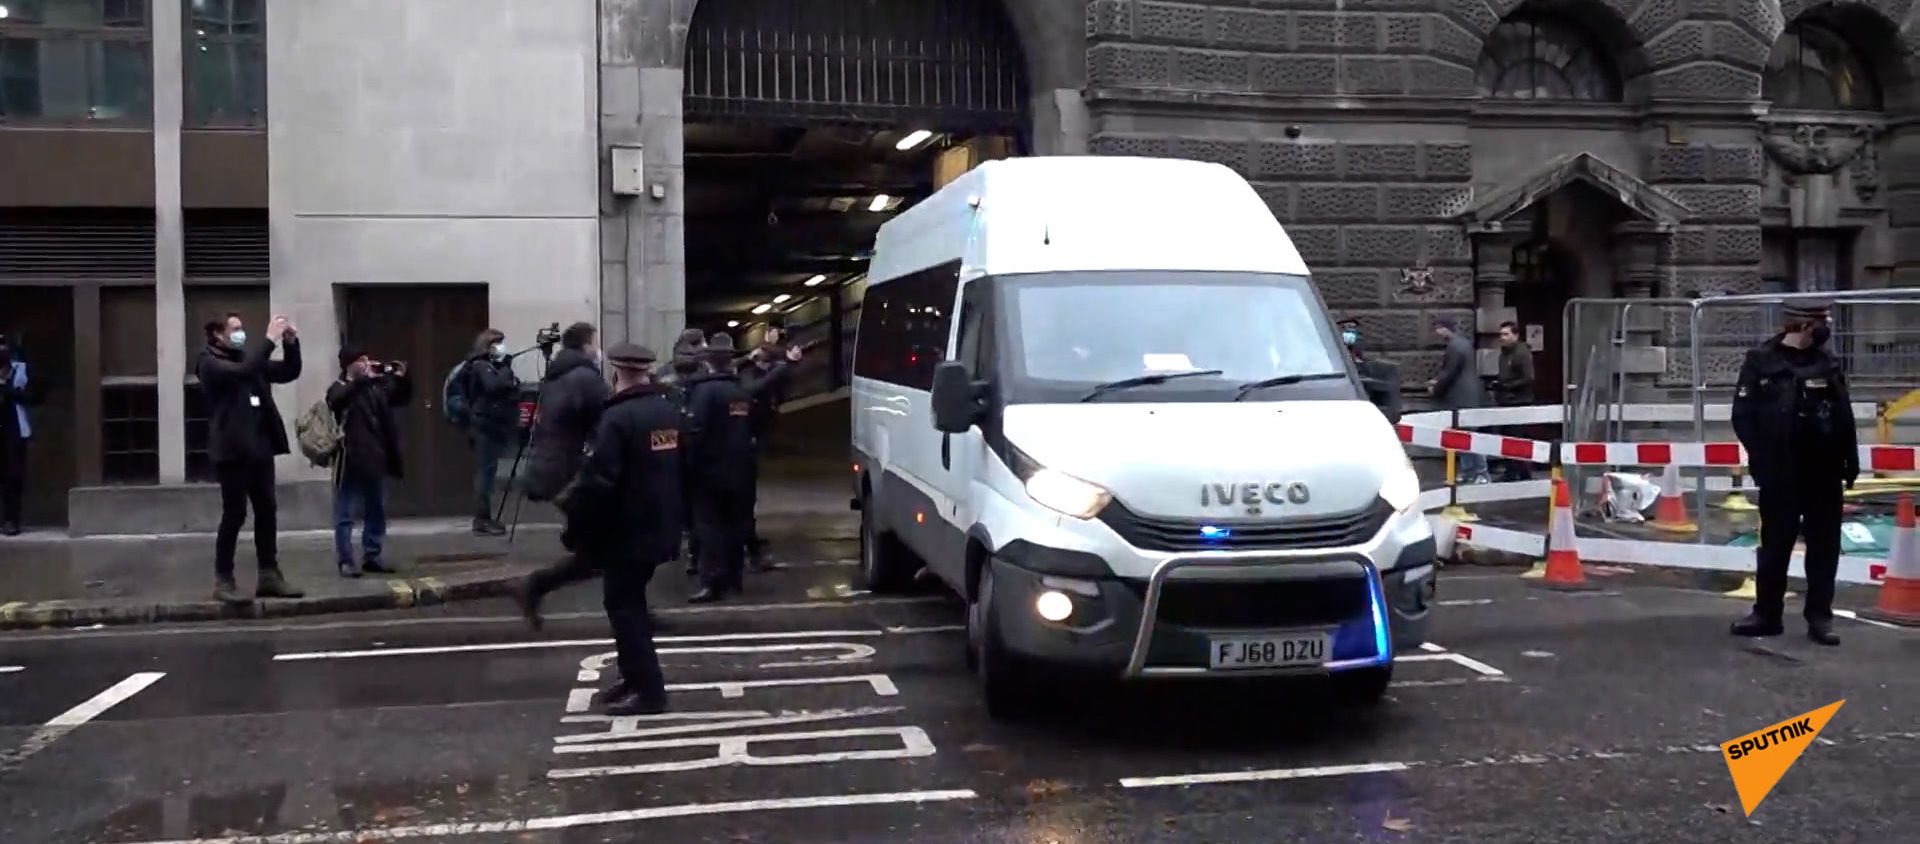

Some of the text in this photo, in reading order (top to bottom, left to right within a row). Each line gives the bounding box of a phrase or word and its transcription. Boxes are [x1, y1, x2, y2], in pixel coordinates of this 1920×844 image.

[1201, 482, 1310, 507] IVECO
[1219, 639, 1324, 664] FJ68 DZU
